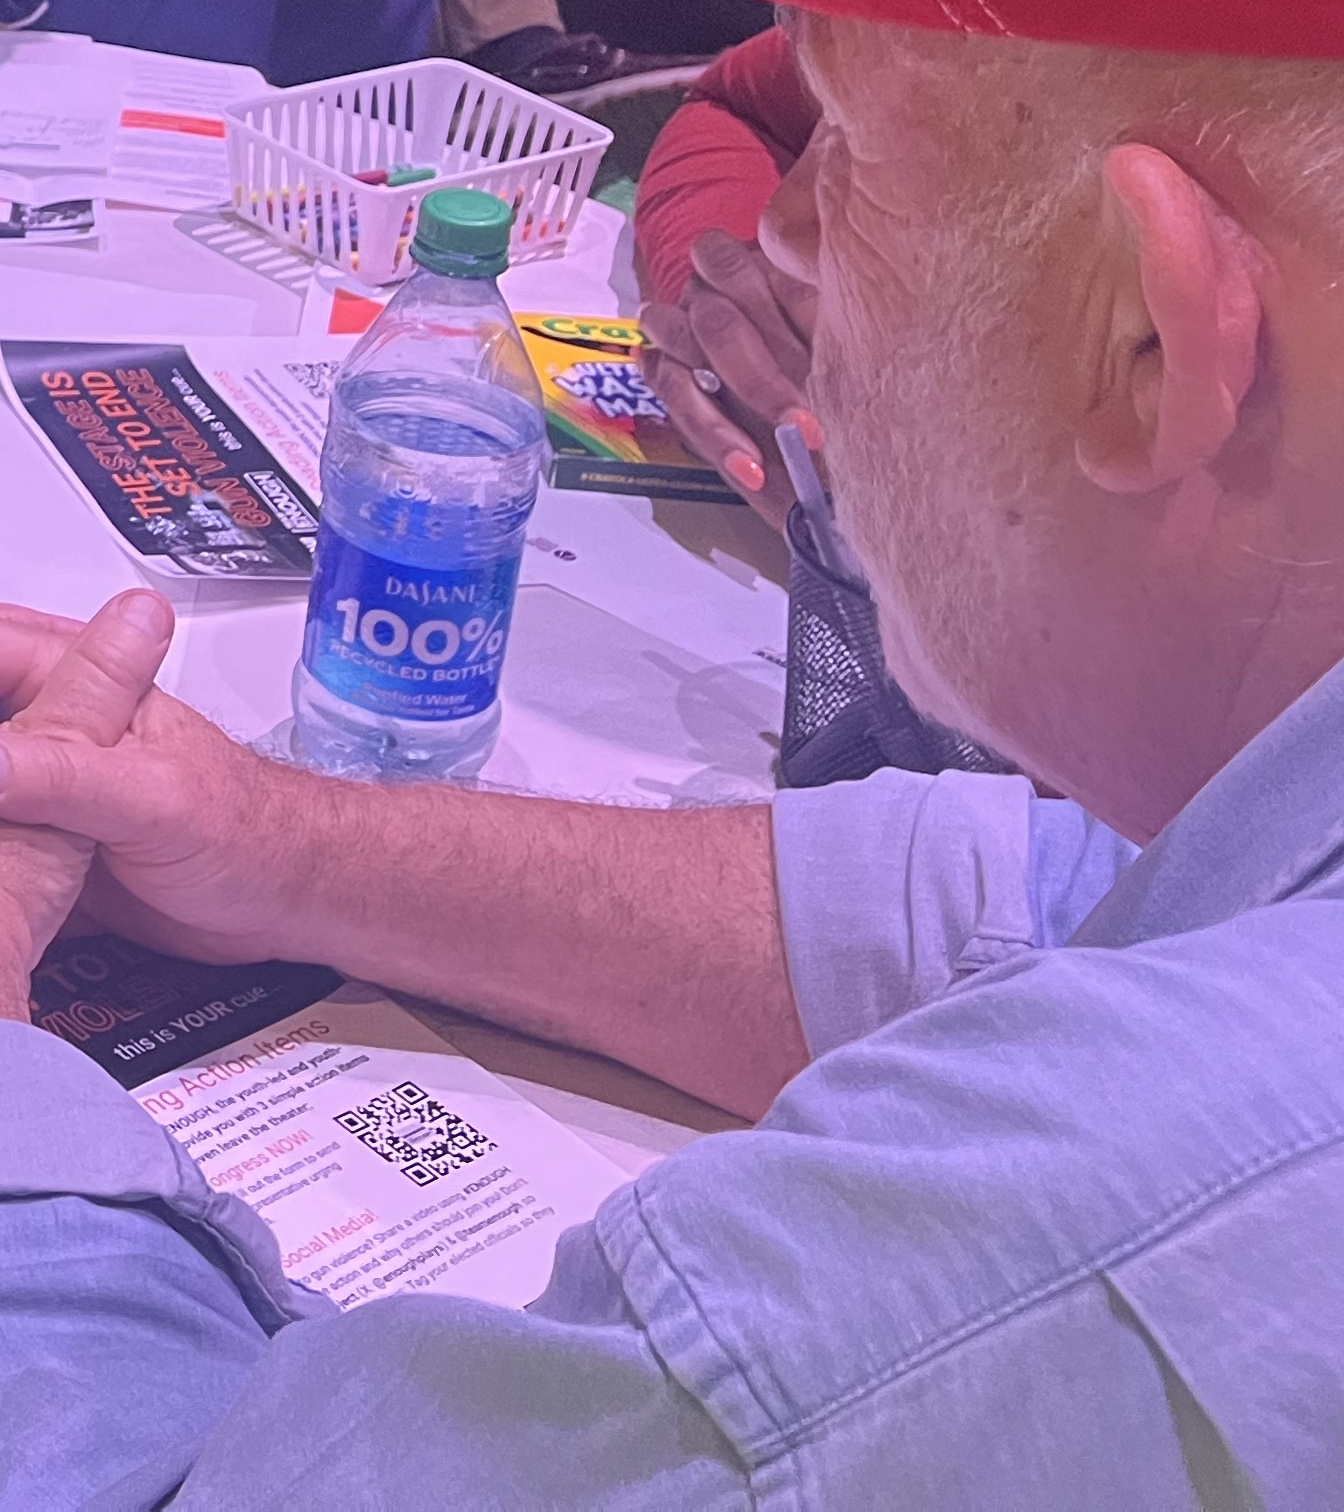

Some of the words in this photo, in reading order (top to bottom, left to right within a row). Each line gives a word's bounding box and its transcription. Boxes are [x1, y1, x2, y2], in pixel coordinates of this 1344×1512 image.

[42, 371, 81, 397] IS
[82, 371, 137, 417] END
[117, 369, 226, 475] VIOLENCE
[183, 394, 216, 423] YOUR
[210, 422, 226, 432] is
[55, 400, 136, 471] STAGE
[117, 421, 162, 452] TO
[218, 431, 242, 451] this
[114, 471, 173, 520] THE
[141, 456, 200, 498] SET
[205, 478, 271, 528] GUN
[386, 576, 476, 605] DASANI
[336, 598, 504, 665] 100%
[330, 642, 427, 680] RECYCLED
[50, 951, 111, 993] TO
[114, 1038, 156, 1060] this
[150, 1029, 176, 1044] is
[168, 1001, 234, 1033] YOUR
[178, 1054, 262, 1097] Action
[253, 1020, 330, 1060] Items
[264, 1129, 314, 1158] NOW!
[322, 1208, 375, 1244] Media!
